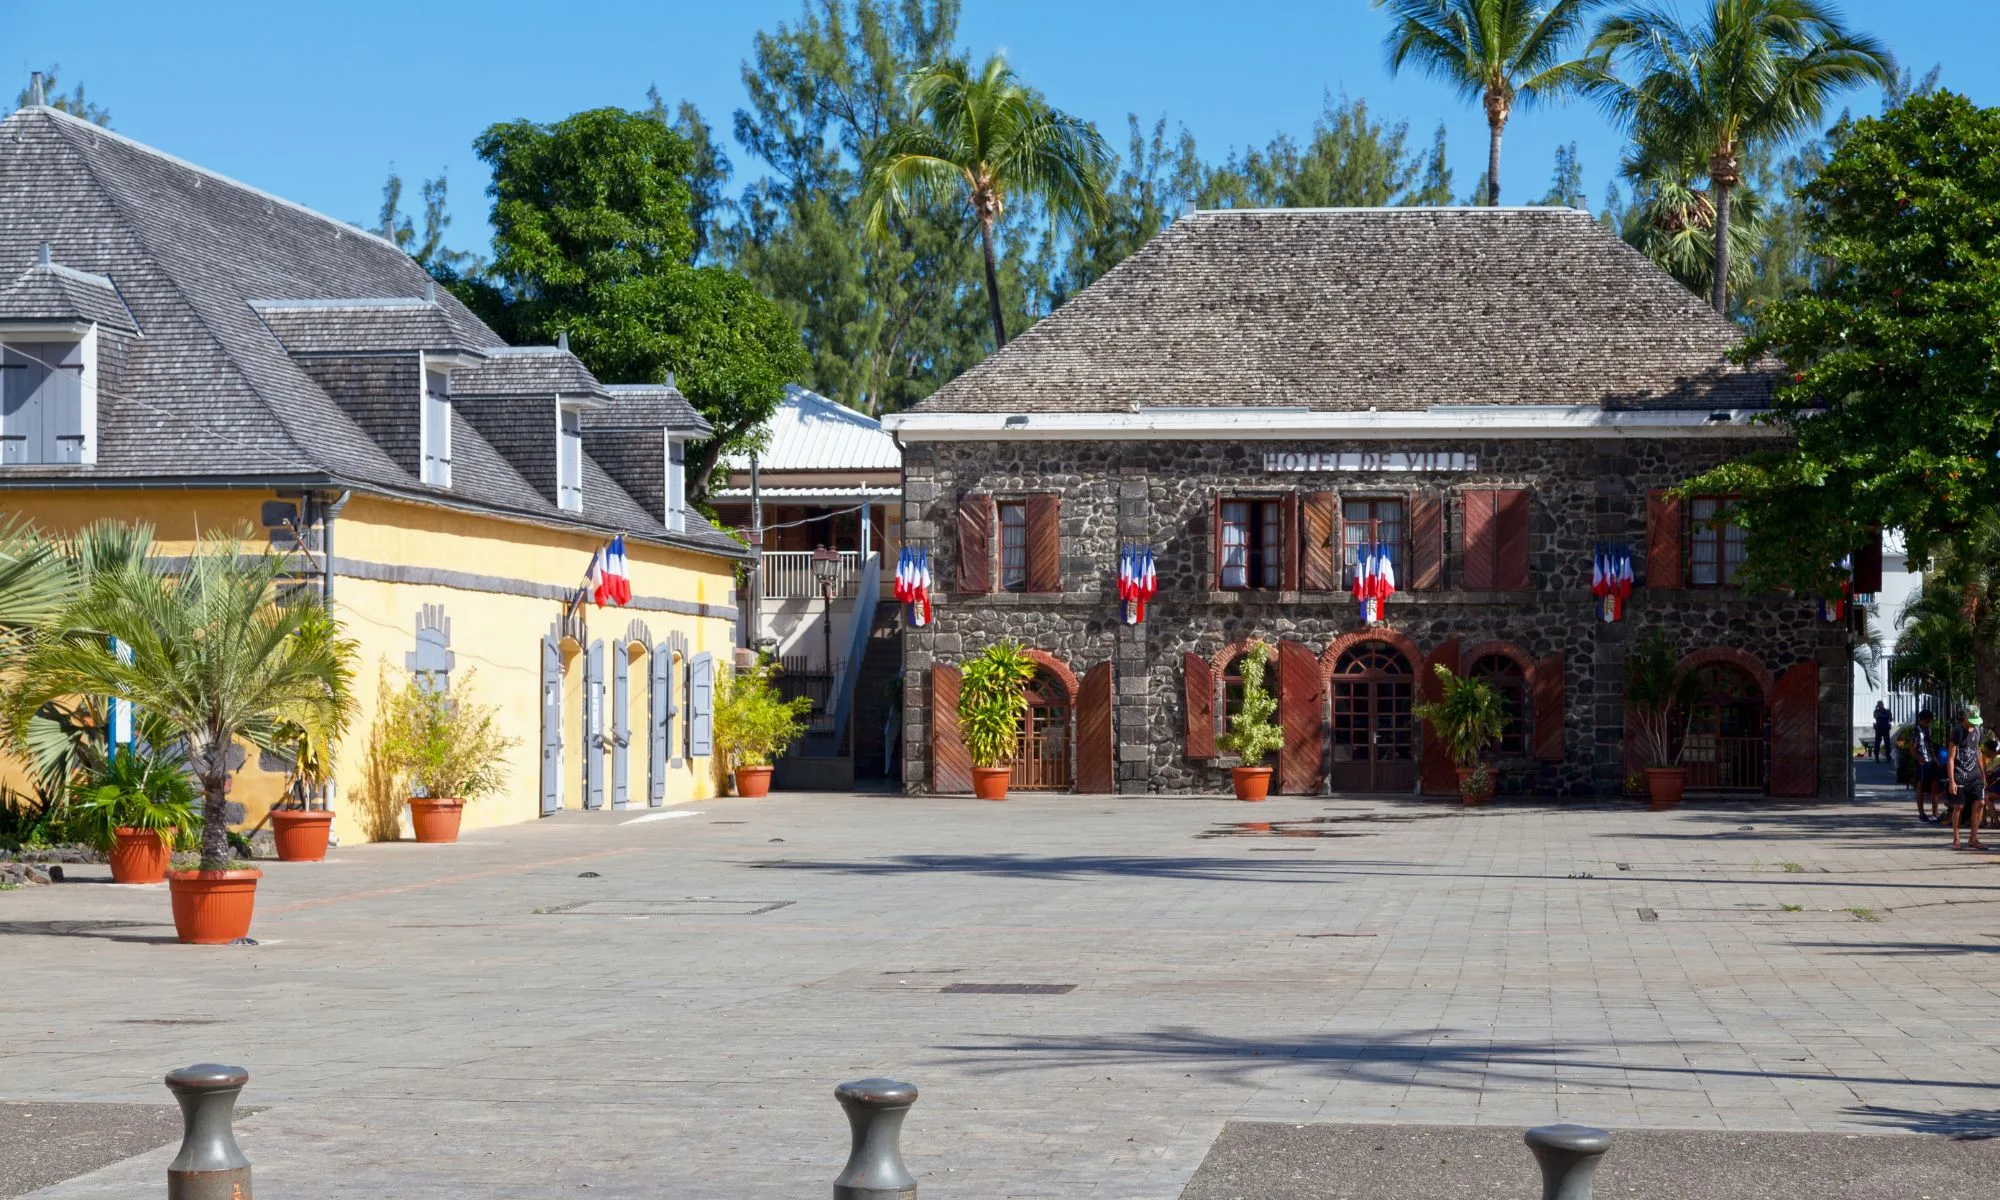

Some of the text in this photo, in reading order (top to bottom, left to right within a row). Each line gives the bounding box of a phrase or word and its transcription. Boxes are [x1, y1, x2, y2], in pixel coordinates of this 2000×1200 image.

[1264, 452, 1477, 472] HOTEL DE VILLE
